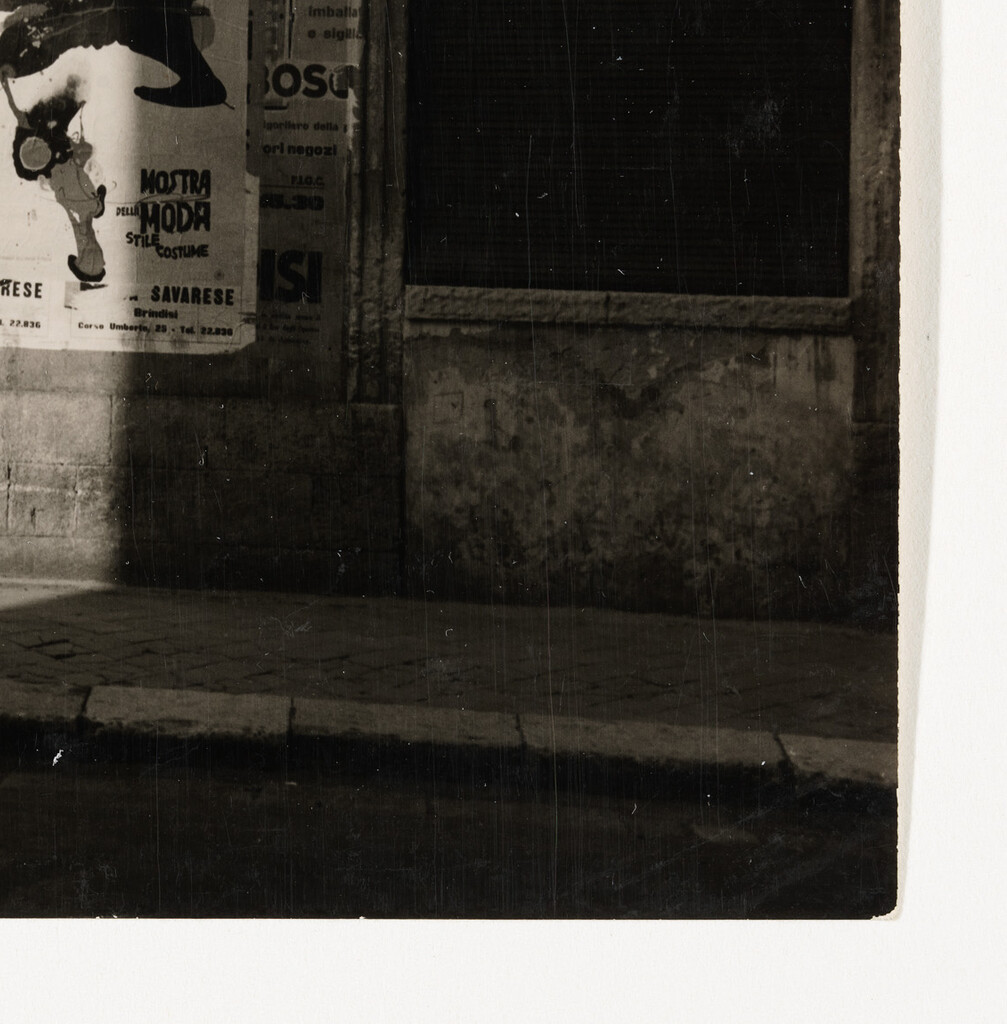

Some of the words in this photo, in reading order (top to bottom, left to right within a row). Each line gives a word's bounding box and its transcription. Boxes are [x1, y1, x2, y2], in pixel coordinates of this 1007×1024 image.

[308, 5, 360, 18] imballa
[307, 29, 317, 39] e
[313, 121, 339, 132] della
[287, 143, 338, 158] negozi
[140, 168, 212, 196] MOSTRA
[139, 201, 211, 234] MODA
[125, 231, 161, 248] STILE
[154, 243, 210, 260] COSTUME
[150, 285, 235, 306] SAVARESE
[133, 307, 178, 319] Brindisi
[154, 324, 167, 333] 25
